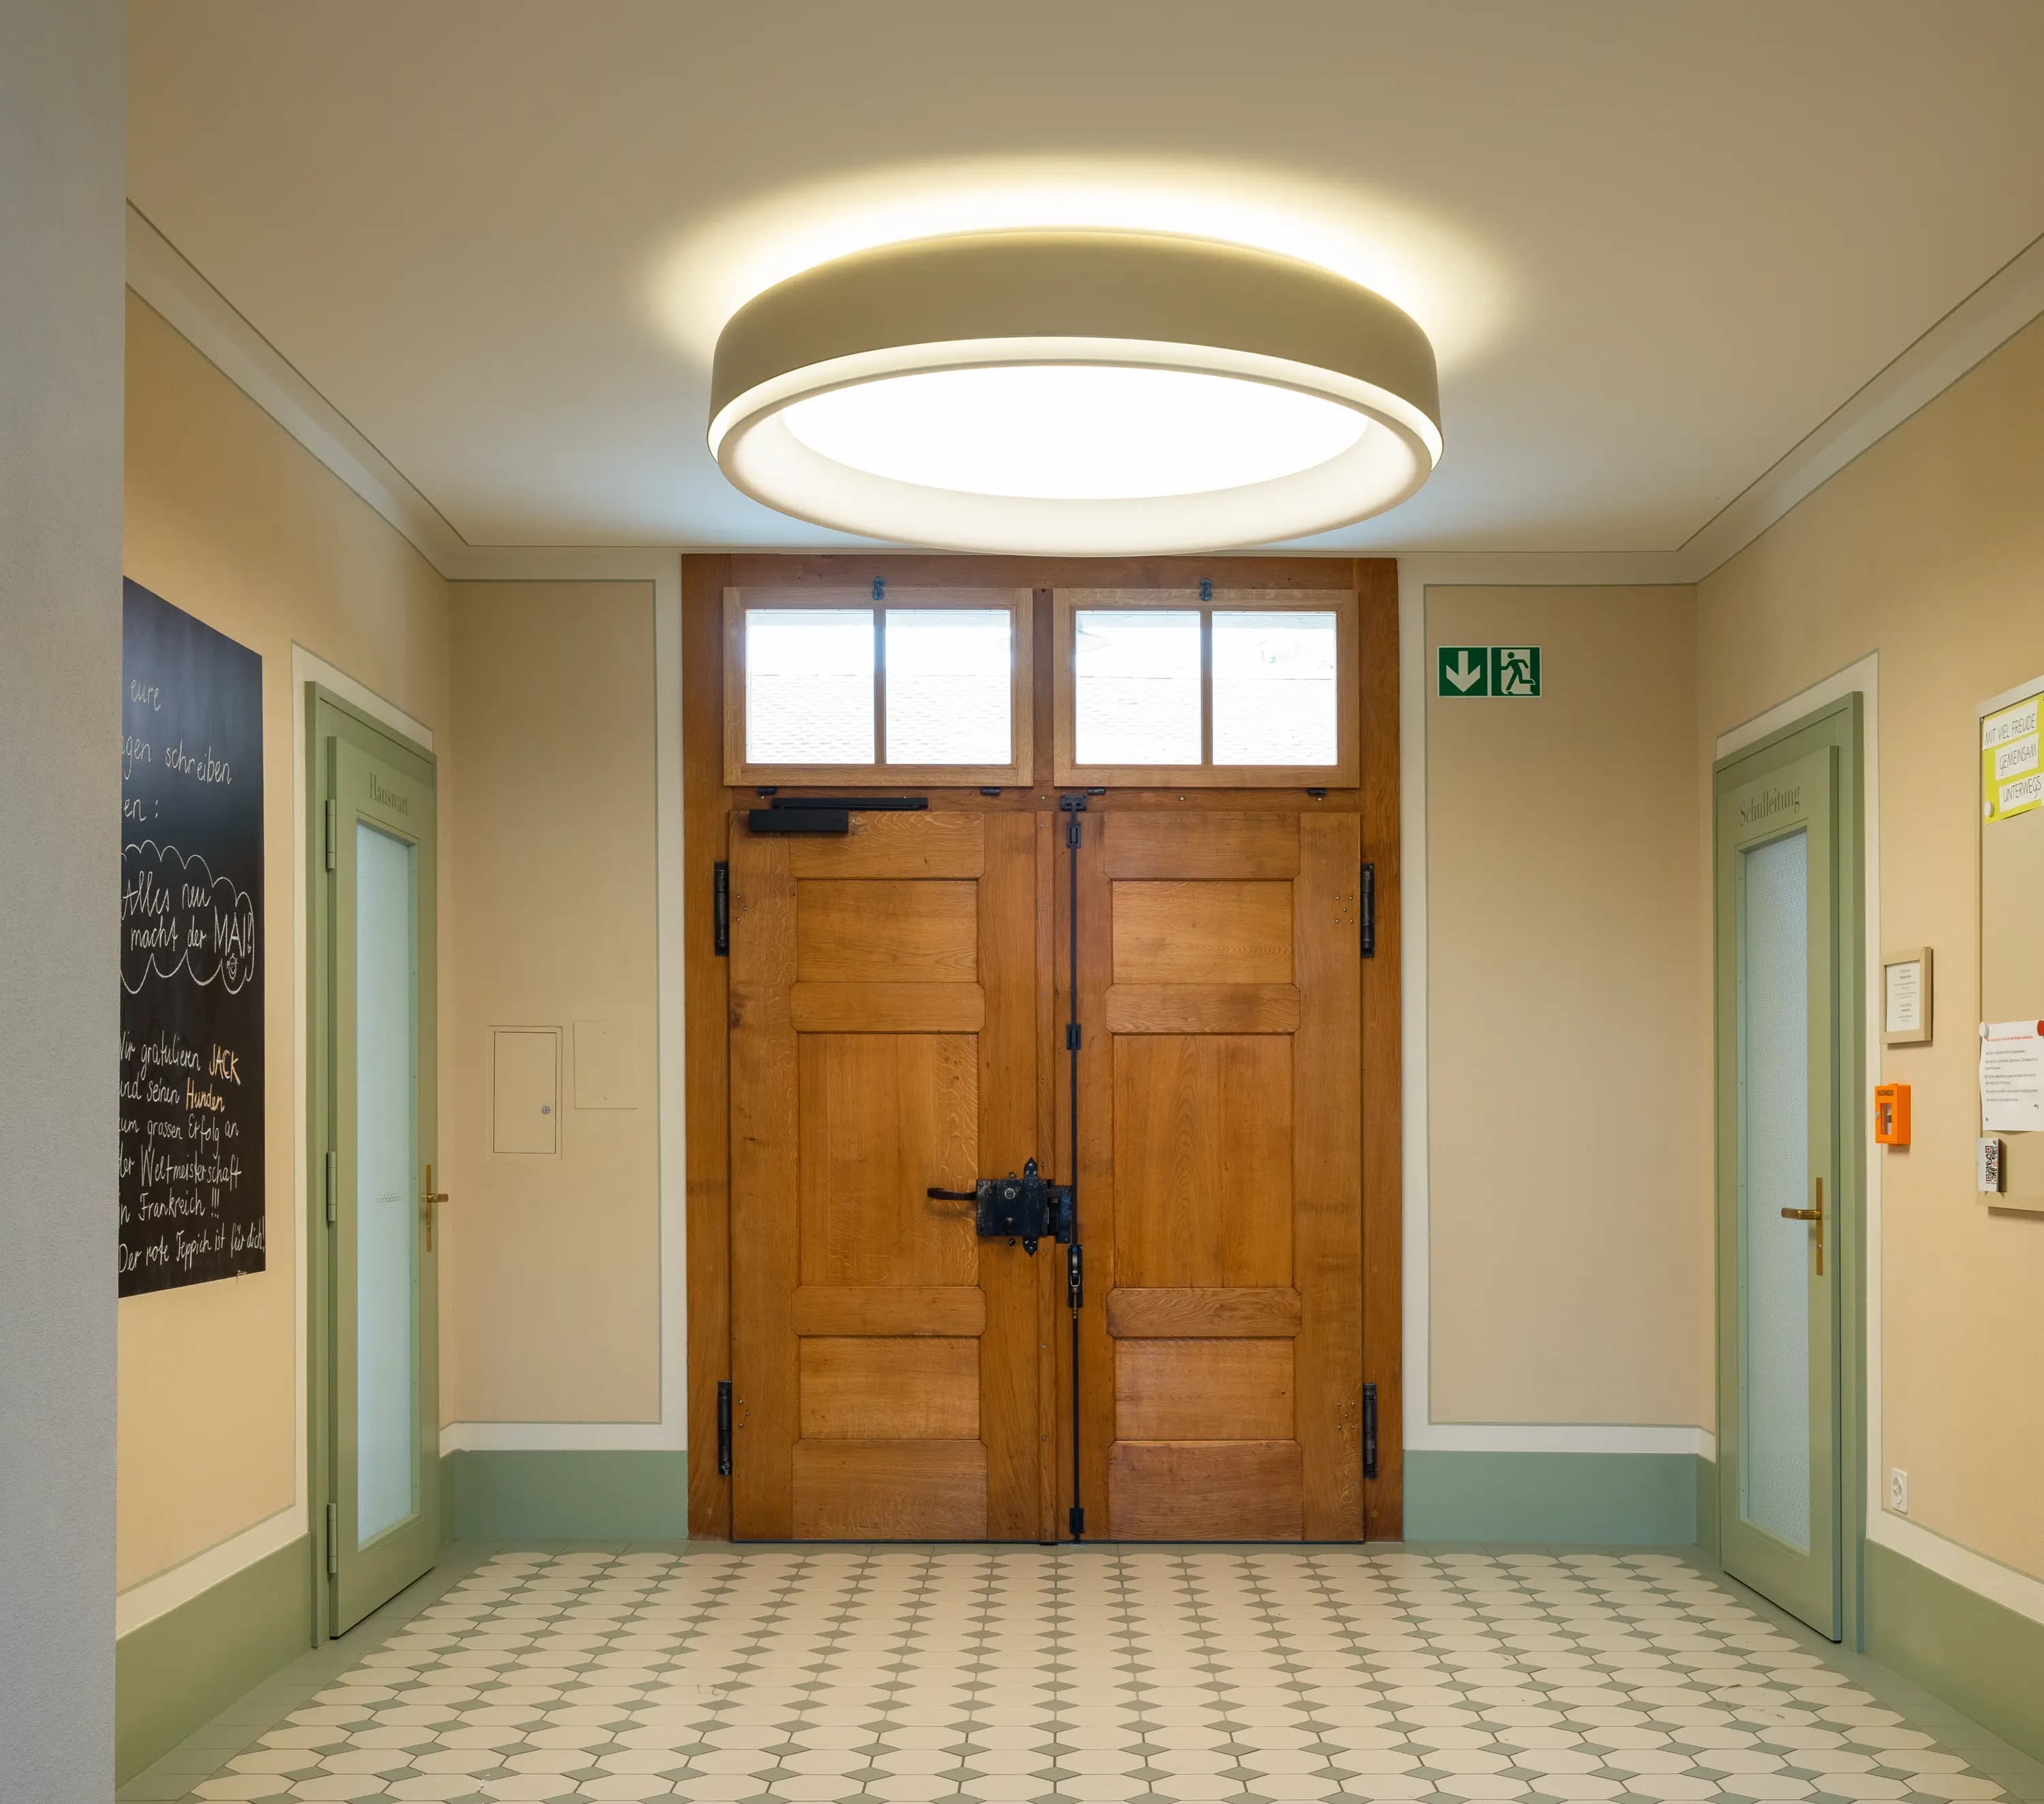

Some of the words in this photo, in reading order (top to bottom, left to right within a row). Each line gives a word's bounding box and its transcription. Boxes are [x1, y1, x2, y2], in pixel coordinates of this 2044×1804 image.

[130, 678, 161, 711] eure
[1984, 728, 1997, 747] MIT
[1998, 724, 2010, 740] VIEL
[2011, 713, 2036, 734] FREUDE
[166, 740, 232, 785] schreiben
[1999, 743, 2037, 777] GEMEINSAM
[1739, 786, 1801, 827] Schulleitung
[2003, 775, 2042, 803] UNTERWEGS
[121, 871, 170, 920] Alles
[182, 883, 211, 909] neu
[131, 915, 179, 952] macht
[187, 915, 207, 948] der
[214, 905, 251, 959] MAI!
[140, 1029, 201, 1080] gratulieren
[208, 1043, 241, 1085] JACK
[146, 1076, 180, 1104] seinen
[186, 1077, 225, 1114] Hunden
[119, 1117, 140, 1134] um
[147, 1119, 183, 1153] grossen
[188, 1113, 219, 1160] Erfolg
[225, 1120, 239, 1138] an
[141, 1144, 243, 1192] Weltmeisterschaft
[138, 1187, 206, 1222] Frankreich
[119, 1243, 142, 1273] Der
[146, 1234, 170, 1266] rote
[176, 1228, 213, 1273] Teppich
[215, 1222, 226, 1252] ist
[230, 1222, 246, 1259] für
